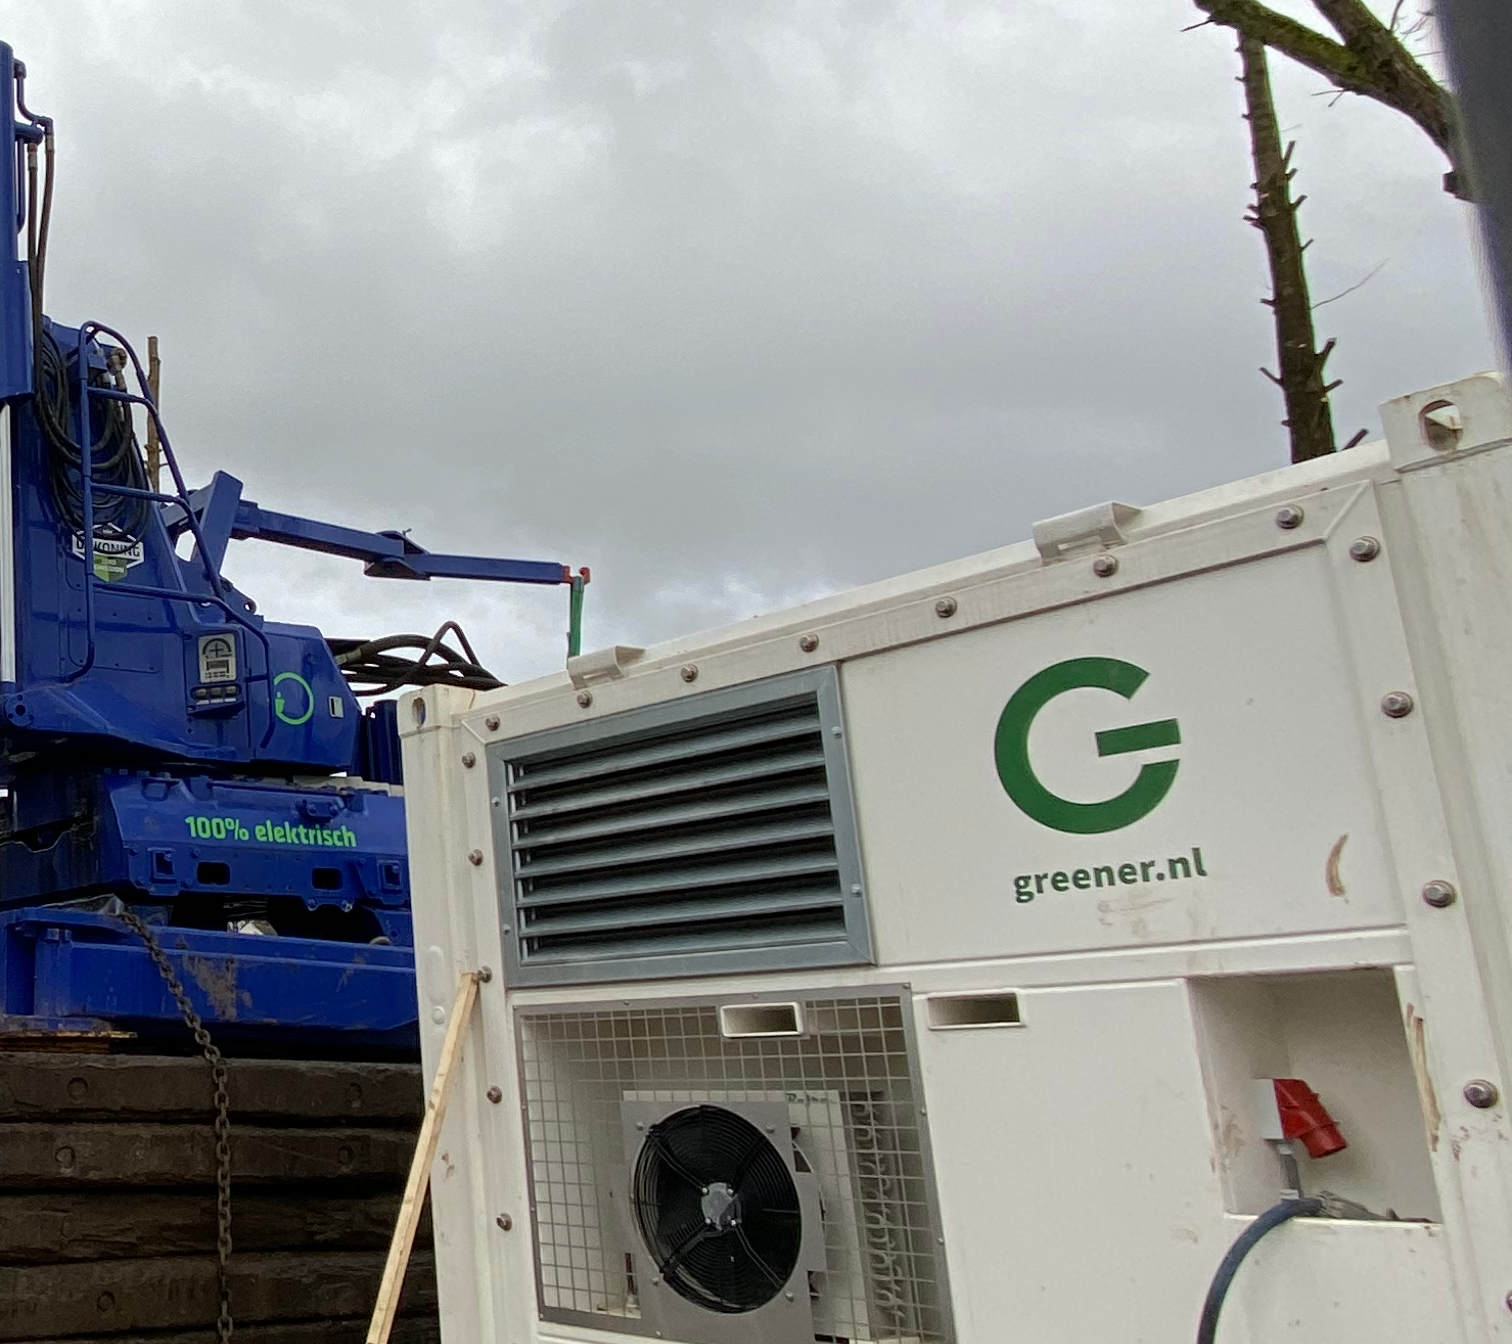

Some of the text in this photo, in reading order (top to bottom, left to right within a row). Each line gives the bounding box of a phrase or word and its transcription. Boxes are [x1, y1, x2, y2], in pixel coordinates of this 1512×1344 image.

[994, 656, 1182, 835] G
[184, 816, 357, 847] 100% elektrisch
[1013, 847, 1208, 903] greener.nl
